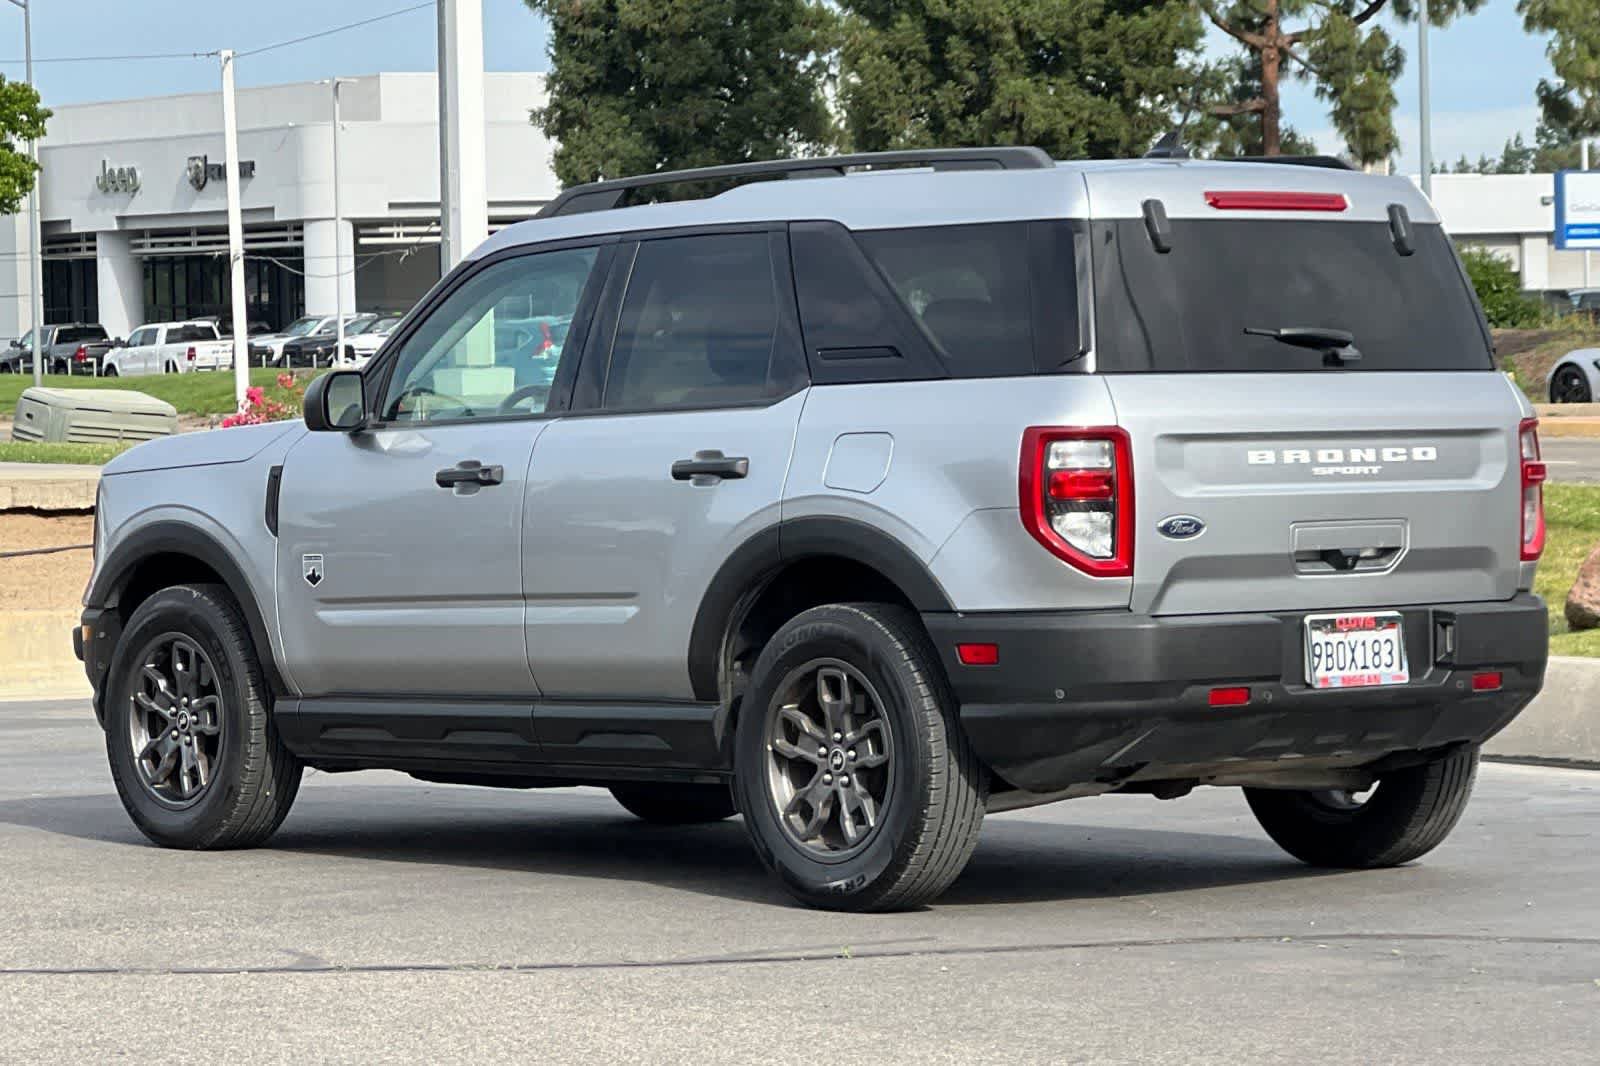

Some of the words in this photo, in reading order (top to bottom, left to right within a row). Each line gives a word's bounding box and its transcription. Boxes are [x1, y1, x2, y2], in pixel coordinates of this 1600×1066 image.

[96, 160, 140, 197] Jeep
[1247, 446, 1437, 464] BRONCO
[1312, 466, 1382, 475] SPORT
[1312, 638, 1394, 672] 9BOX183
